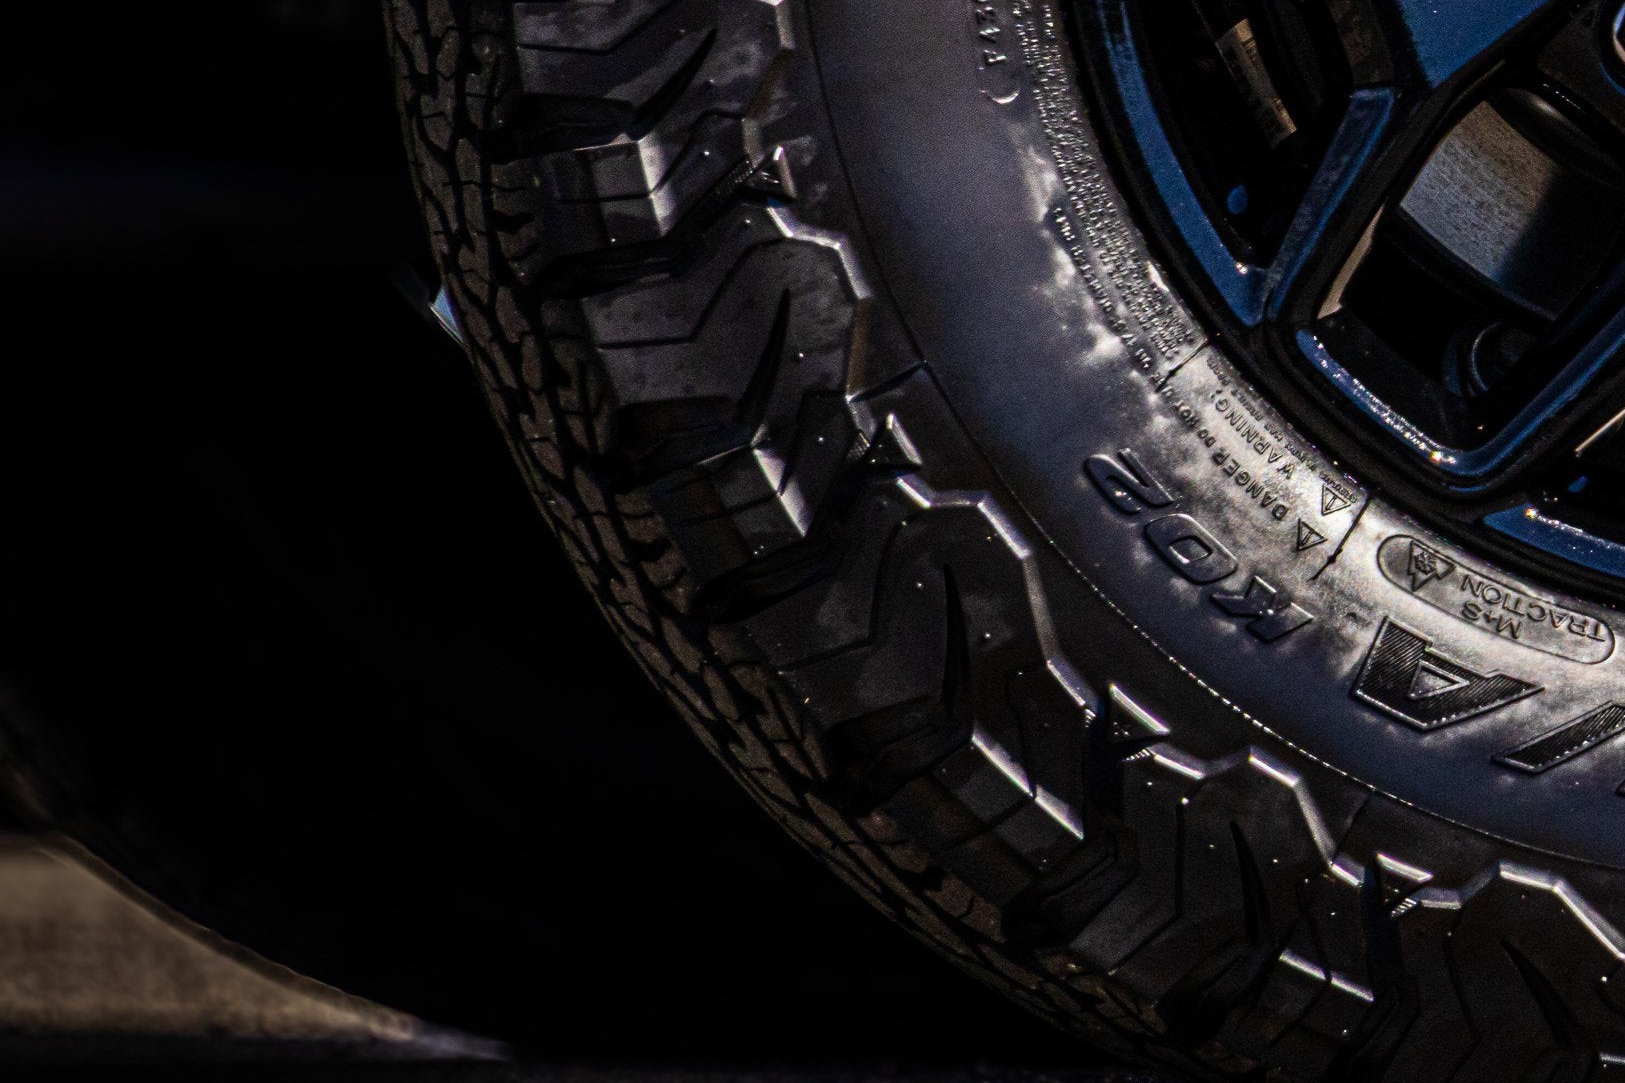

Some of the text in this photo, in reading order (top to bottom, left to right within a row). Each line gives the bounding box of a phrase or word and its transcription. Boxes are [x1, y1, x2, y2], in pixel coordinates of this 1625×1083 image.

[1217, 449, 1288, 522] DANGER
[1083, 452, 1316, 644] KO2
[1457, 572, 1608, 644] TRACTION
[1458, 598, 1524, 640] M+S
